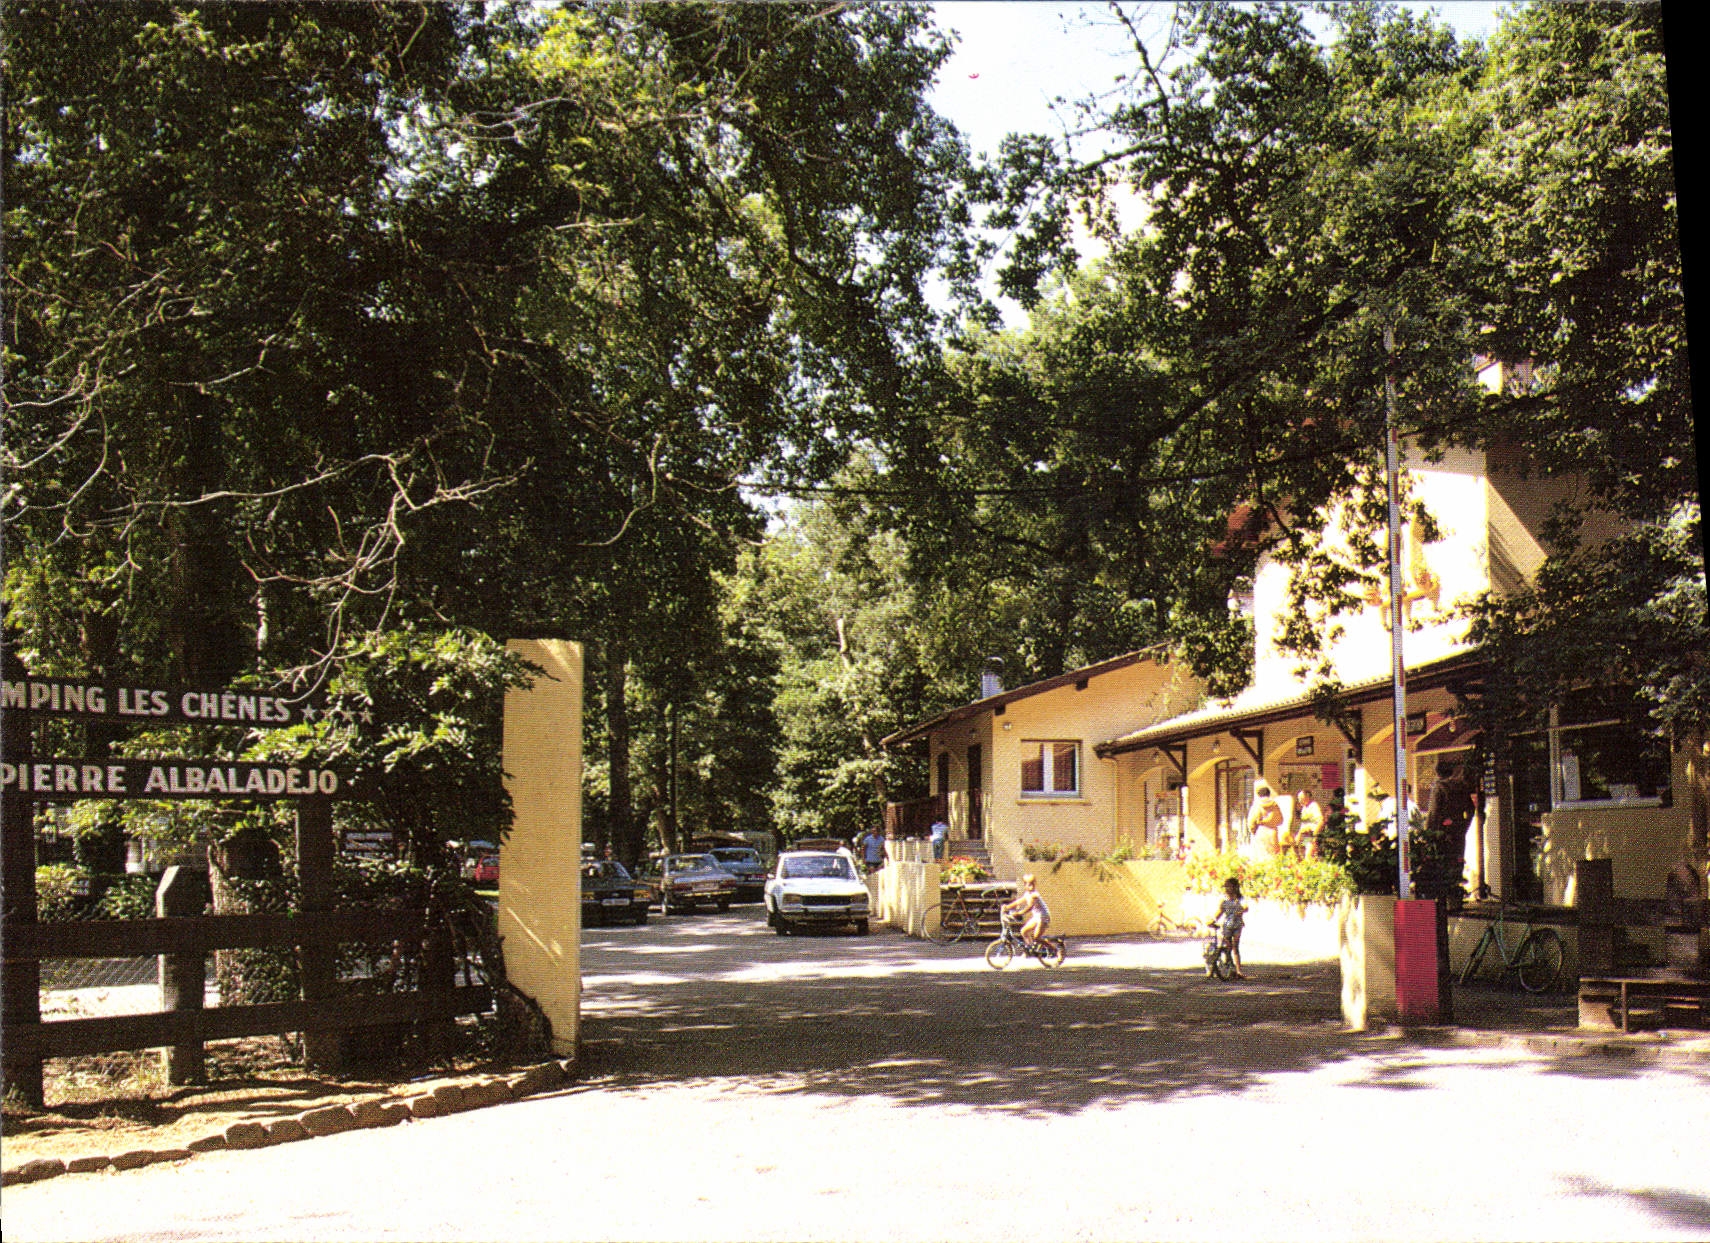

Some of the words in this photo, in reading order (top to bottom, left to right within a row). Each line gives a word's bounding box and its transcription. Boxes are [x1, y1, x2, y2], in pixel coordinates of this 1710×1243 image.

[118, 688, 171, 717] LES
[181, 690, 291, 722] CHÊNES
[0, 762, 128, 792] PIERRE
